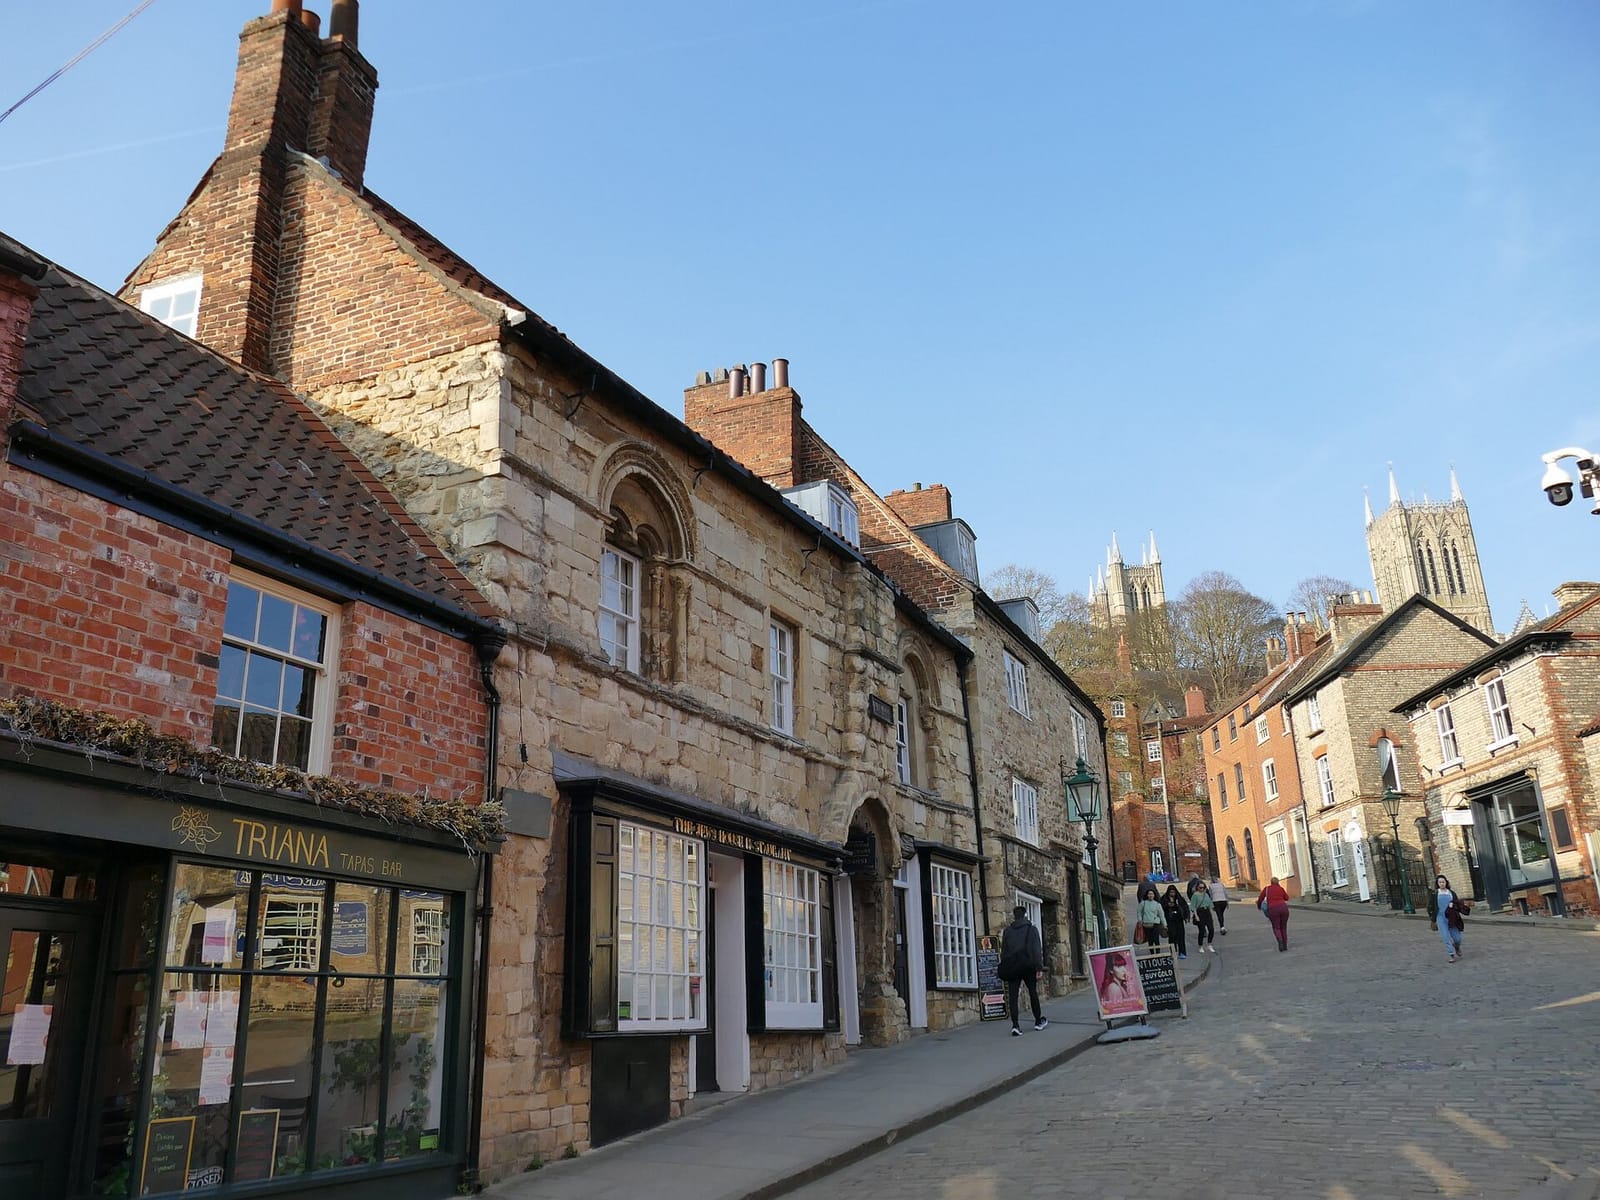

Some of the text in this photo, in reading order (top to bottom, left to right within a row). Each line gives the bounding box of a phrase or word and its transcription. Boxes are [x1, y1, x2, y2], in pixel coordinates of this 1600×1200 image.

[233, 818, 402, 877] TRIANA TAPAS BAR
[1136, 957, 1173, 968] NTIQUES
[1144, 972, 1157, 980] BUY
[1157, 969, 1173, 978] GOLD
